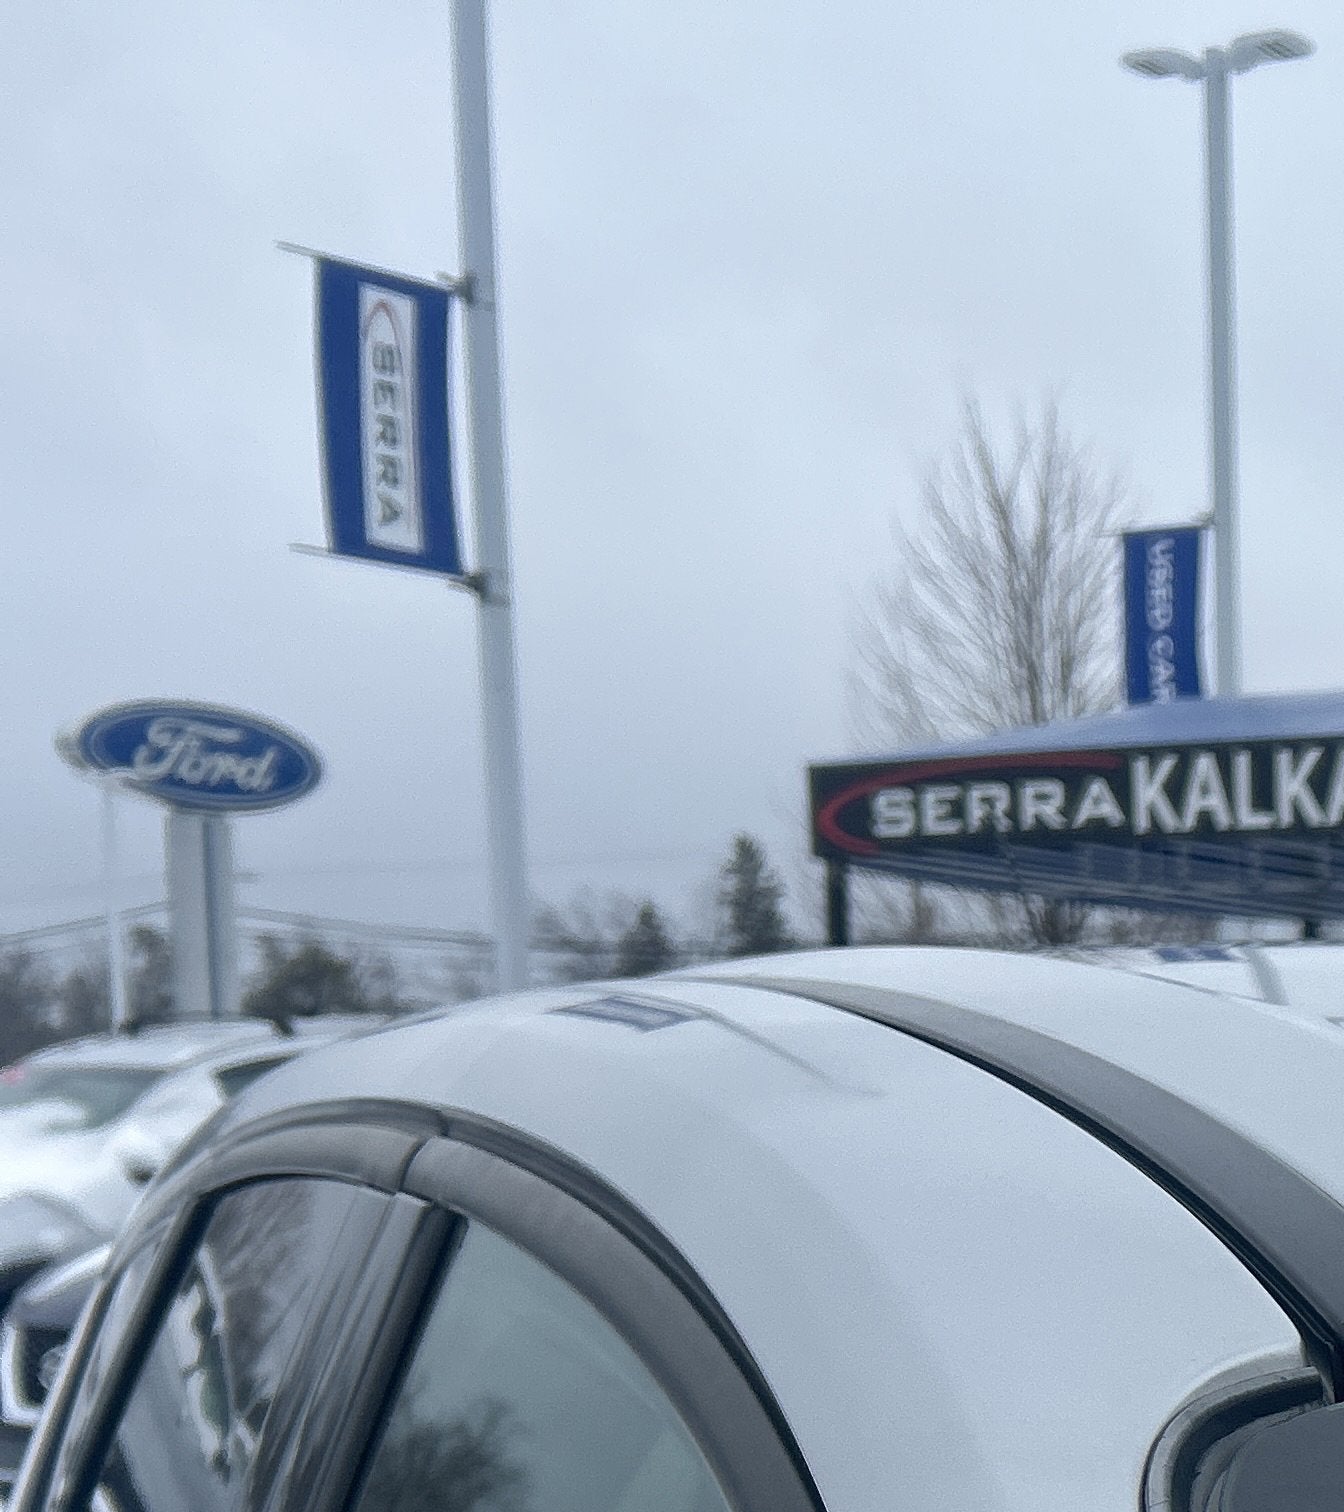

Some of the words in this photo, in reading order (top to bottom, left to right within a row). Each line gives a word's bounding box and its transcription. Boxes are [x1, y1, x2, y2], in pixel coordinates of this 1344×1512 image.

[371, 341, 404, 529] SERRA
[132, 716, 275, 793] Ford
[869, 777, 1127, 838] SERRA
